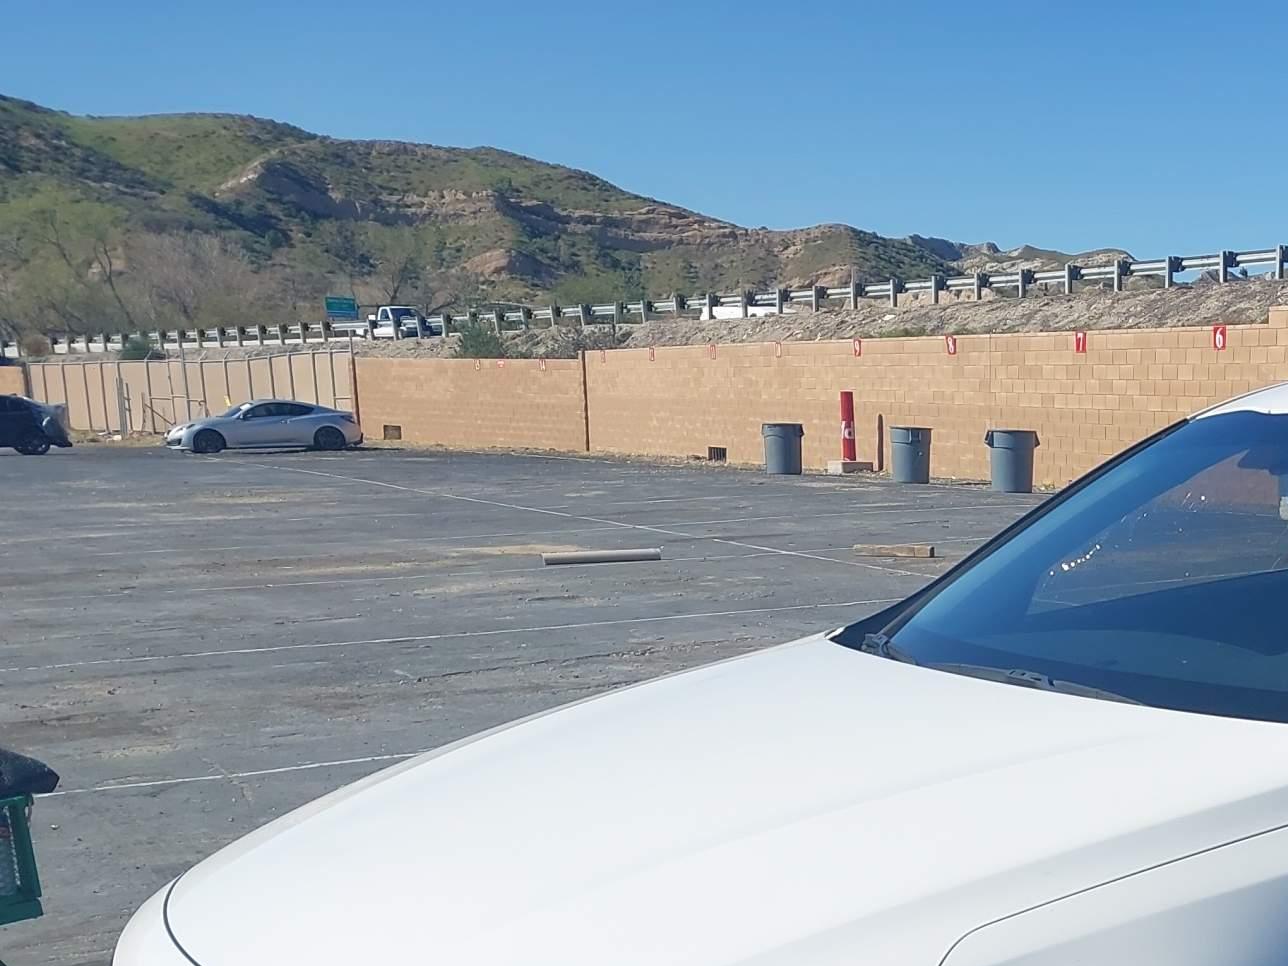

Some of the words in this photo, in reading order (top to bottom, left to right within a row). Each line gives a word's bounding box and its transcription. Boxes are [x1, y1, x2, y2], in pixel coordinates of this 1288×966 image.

[947, 336, 955, 354] 8
[1076, 332, 1084, 352] 7
[1215, 327, 1224, 349] 6
